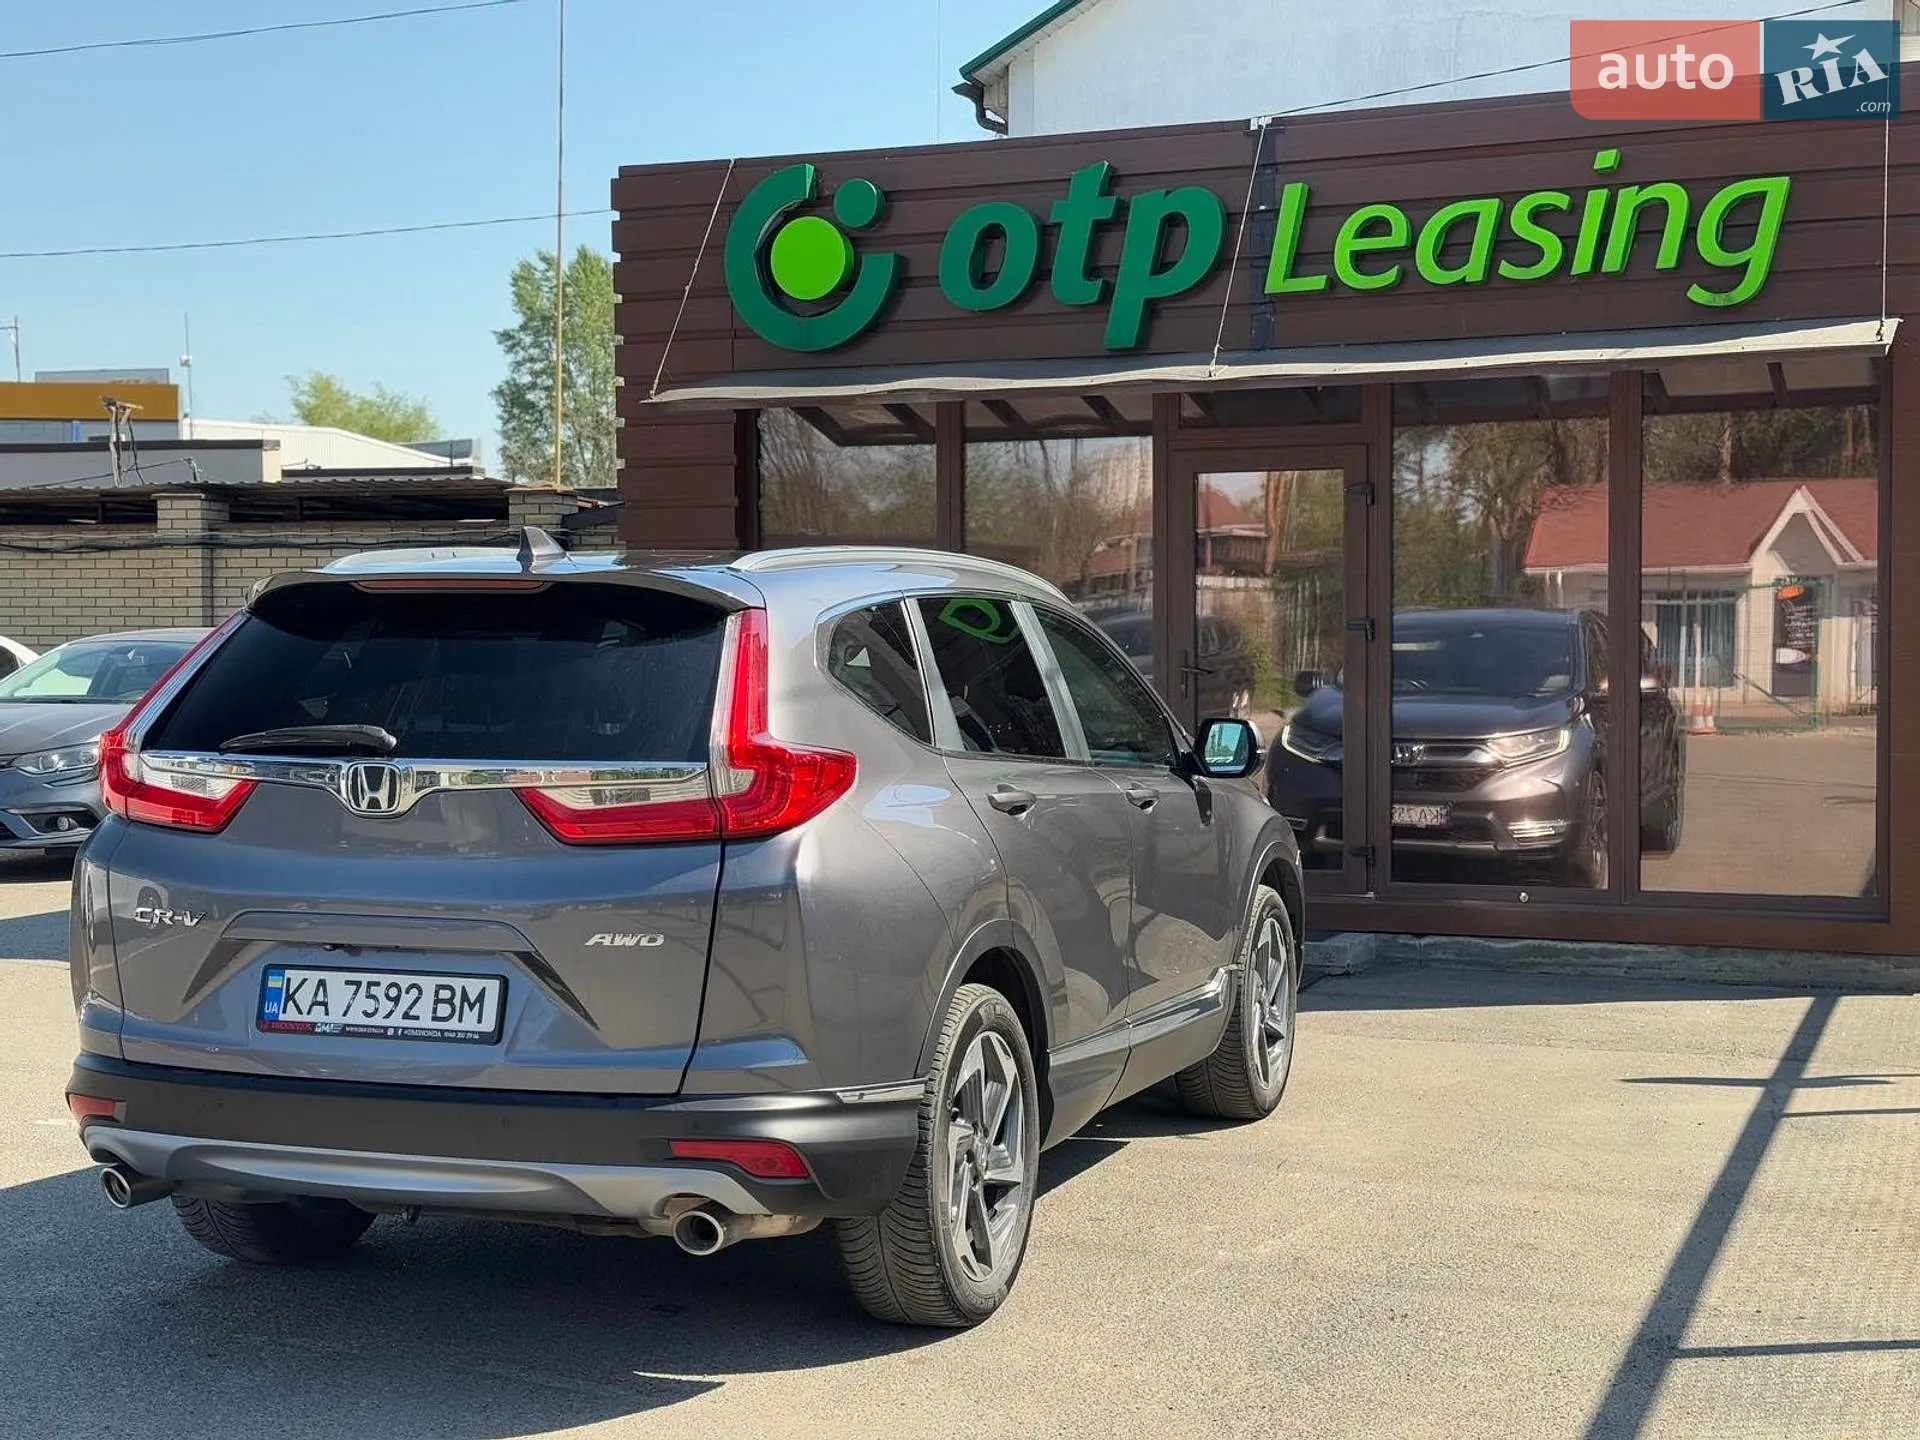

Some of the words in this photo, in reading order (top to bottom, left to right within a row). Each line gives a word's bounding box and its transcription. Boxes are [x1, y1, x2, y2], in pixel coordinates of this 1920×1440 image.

[938, 161, 1225, 350] otp
[1264, 149, 1790, 307] Leasing
[134, 907, 206, 926] CR-V
[584, 933, 665, 946] AWD
[264, 1002, 279, 1014] UA
[282, 977, 329, 1016] KA
[342, 980, 423, 1020] 7592
[431, 984, 487, 1024] BM
